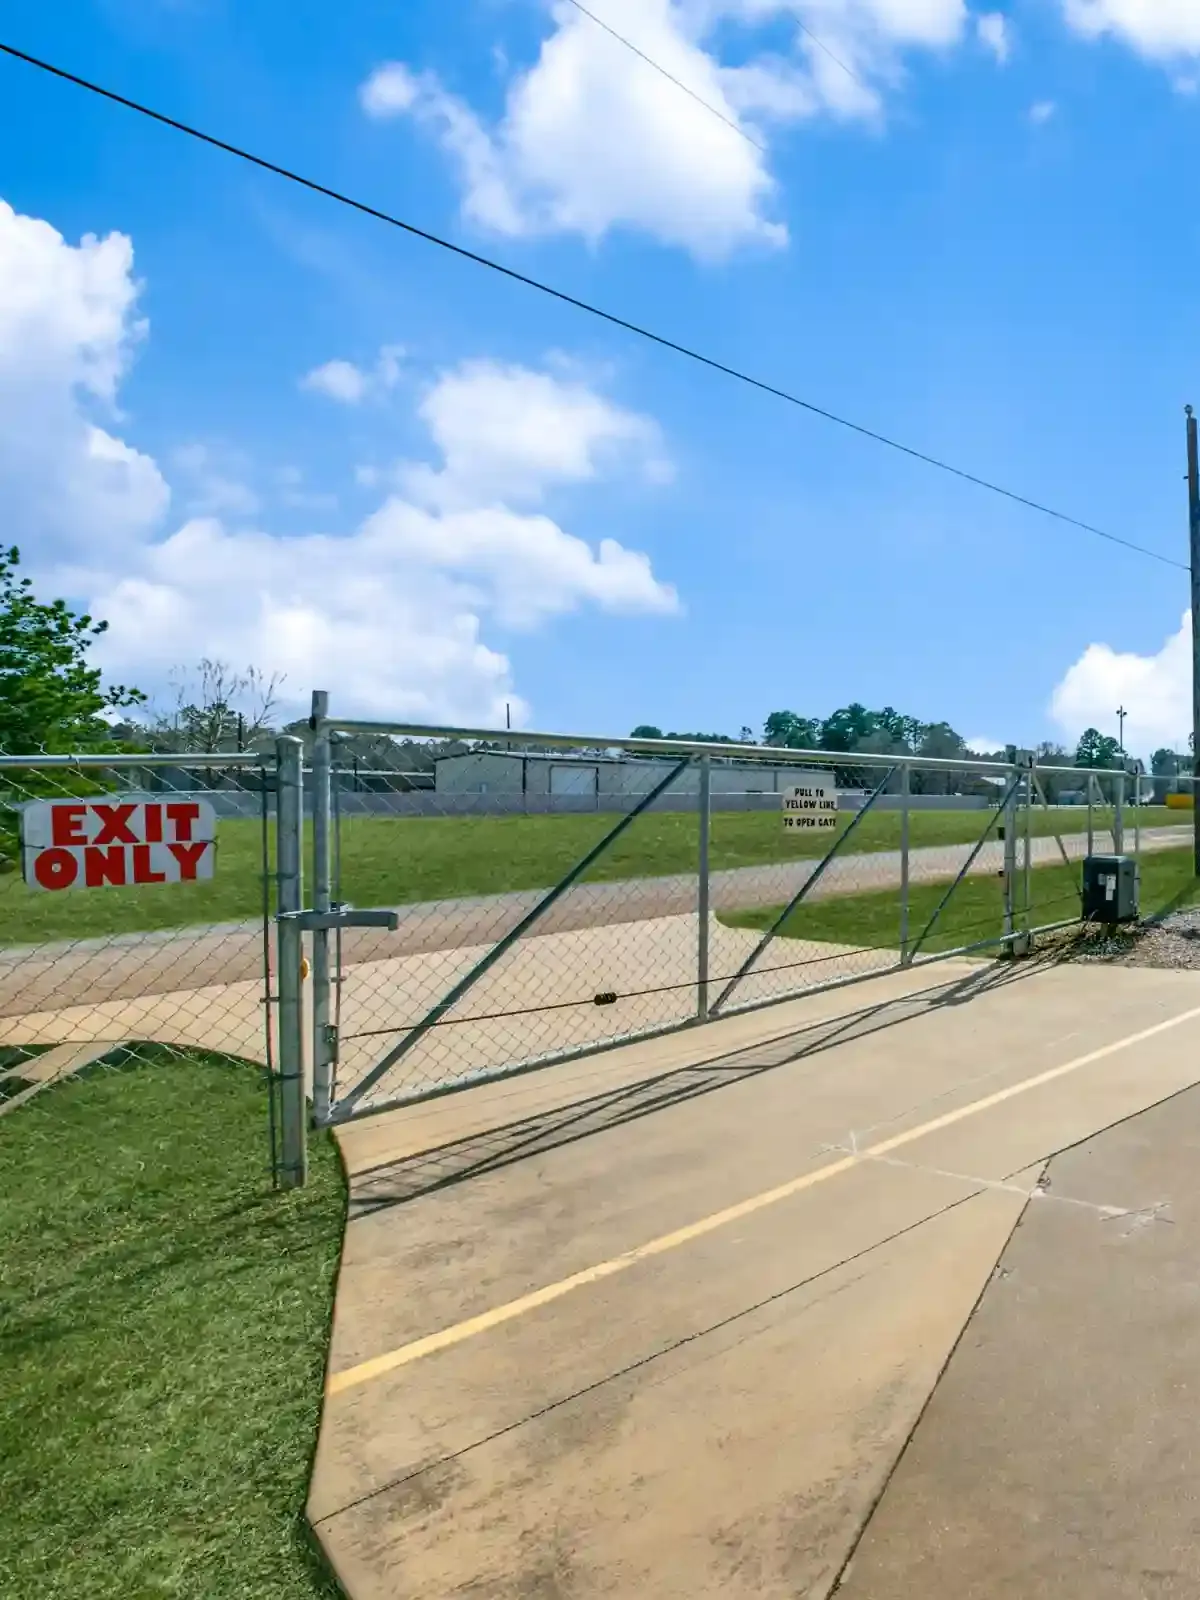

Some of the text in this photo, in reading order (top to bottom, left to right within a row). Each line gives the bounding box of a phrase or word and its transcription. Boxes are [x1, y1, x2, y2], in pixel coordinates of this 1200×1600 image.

[795, 788, 824, 797] PULL TO
[785, 800, 817, 809] YELLOW
[52, 804, 199, 846] EXIT
[784, 818, 836, 827] TO OPEN GATE
[35, 843, 208, 890] ONLY
